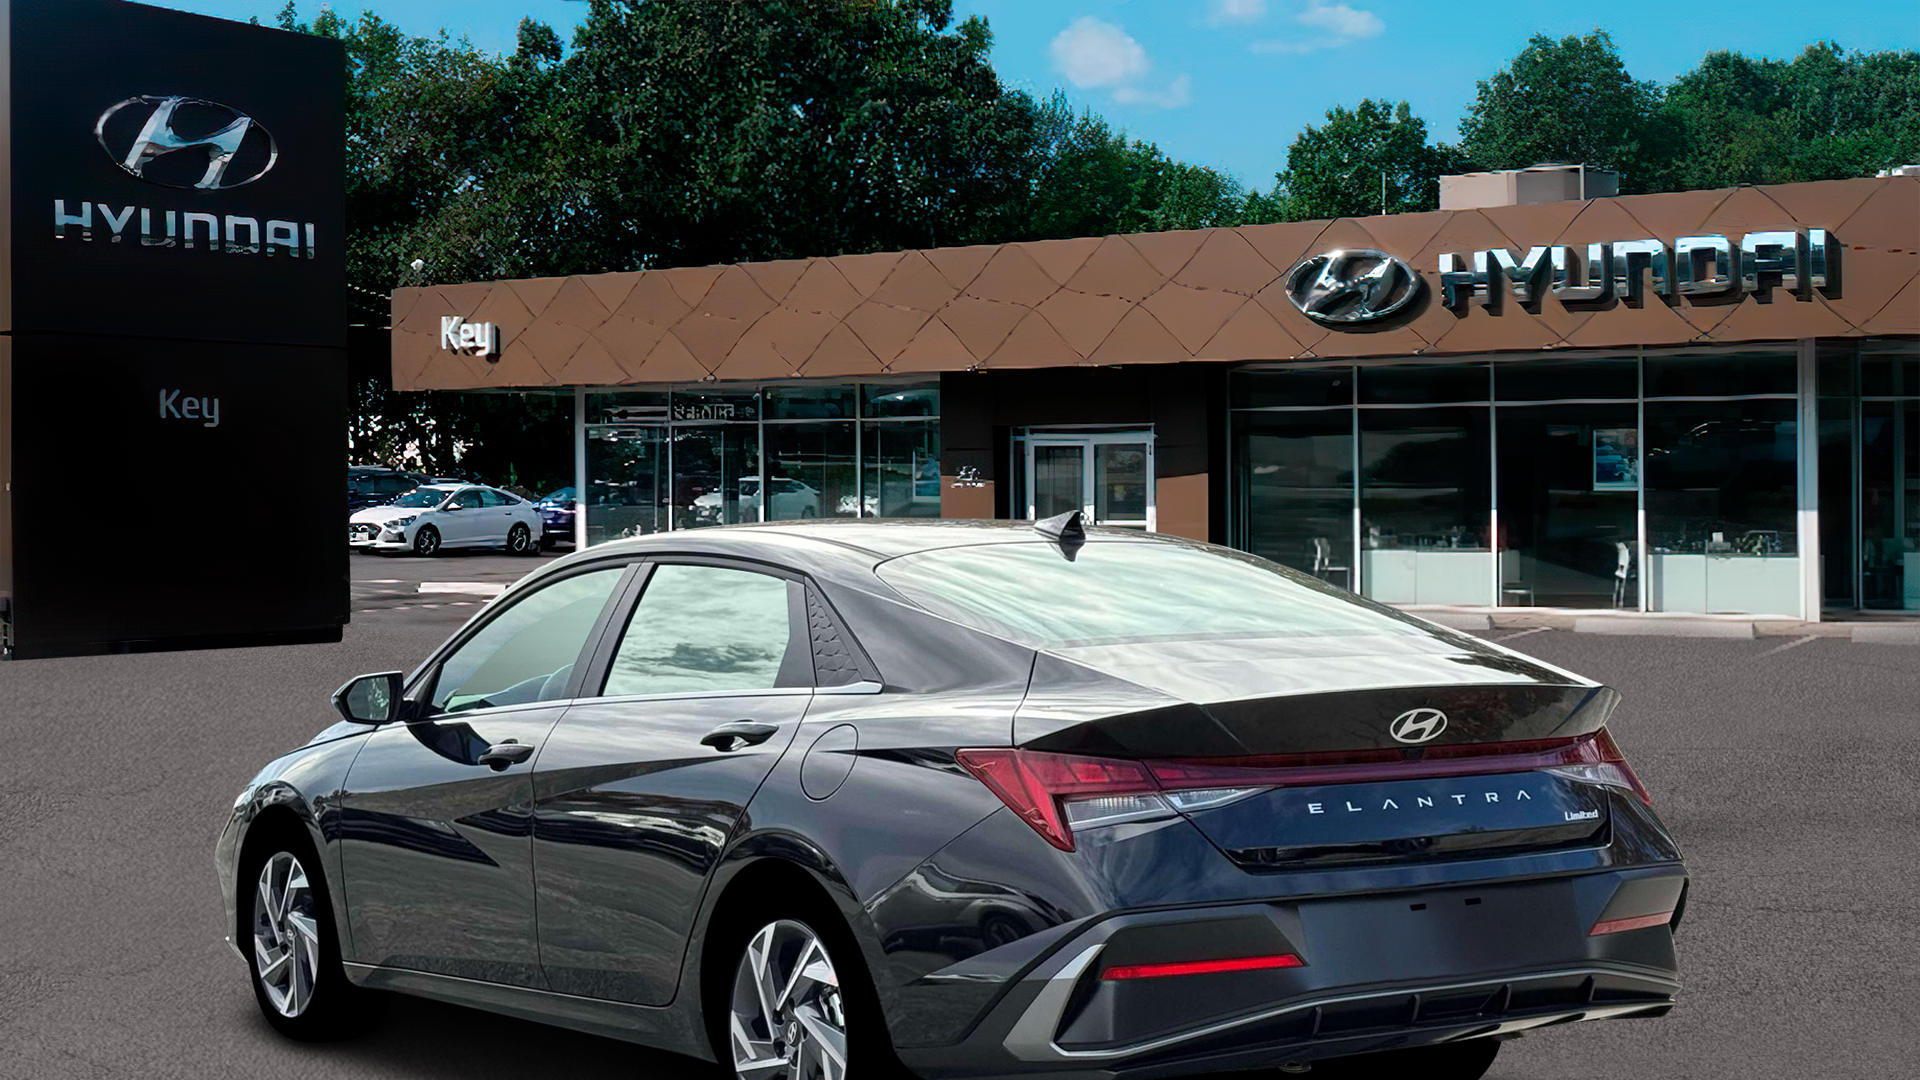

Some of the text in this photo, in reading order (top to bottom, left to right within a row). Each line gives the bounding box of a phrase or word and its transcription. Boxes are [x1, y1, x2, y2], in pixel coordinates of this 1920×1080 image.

[55, 199, 314, 260] HYUNDAI
[1438, 228, 1834, 311] HYUNDAI
[441, 315, 493, 357] Key
[159, 388, 219, 428] Key
[1308, 789, 1532, 815] ELANTRA
[1564, 808, 1599, 821] Limited
